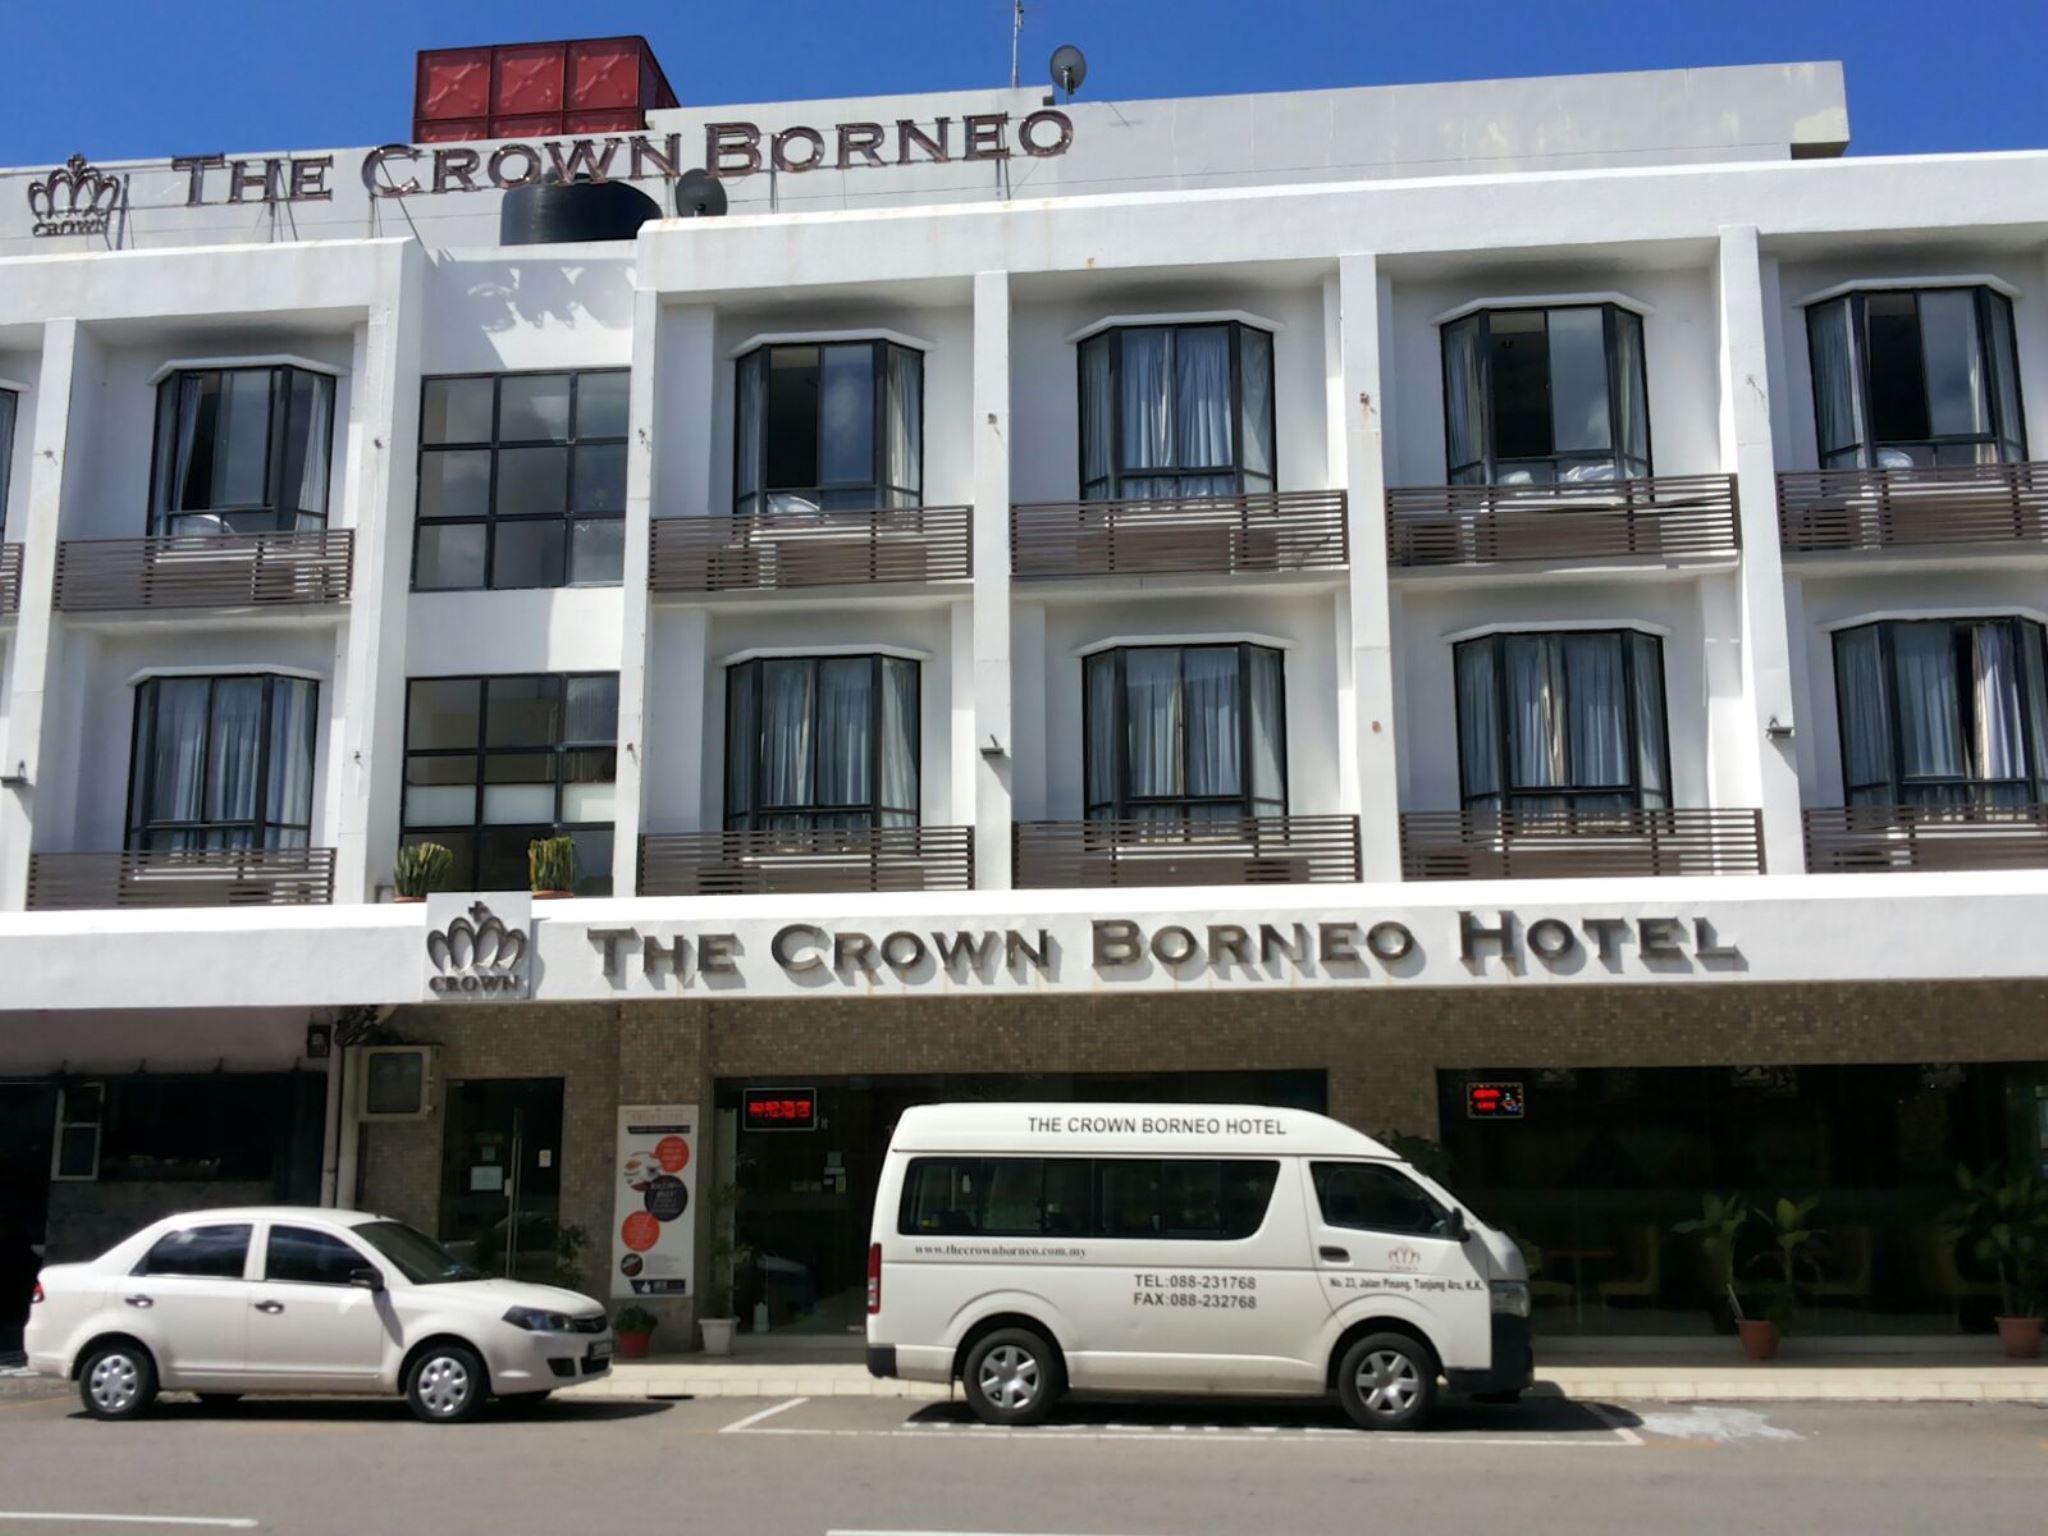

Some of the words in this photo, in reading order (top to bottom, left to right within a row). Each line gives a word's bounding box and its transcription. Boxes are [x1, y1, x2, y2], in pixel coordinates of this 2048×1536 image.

[171, 152, 333, 207] THE
[361, 133, 682, 198] CROWN
[704, 109, 1073, 178] BORNEO
[587, 925, 737, 976] THE
[771, 923, 1050, 972] CROWN
[1091, 918, 1413, 968] BORNEO
[1459, 909, 1738, 962] HOTEL
[429, 975, 520, 993] CROWN
[1028, 1116, 1062, 1133] THE
[1067, 1117, 1136, 1133] CROWN
[1142, 1117, 1221, 1134] BORNEO
[1226, 1118, 1287, 1136] HOTEL
[914, 1243, 1086, 1260] www.thecrownborneo.com.my
[1133, 1274, 1257, 1290] TEL:088-231768
[1360, 1278, 1381, 1289] Jalan
[1414, 1279, 1446, 1292] Tanjung
[1133, 1291, 1257, 1309] FAX:088-232768
